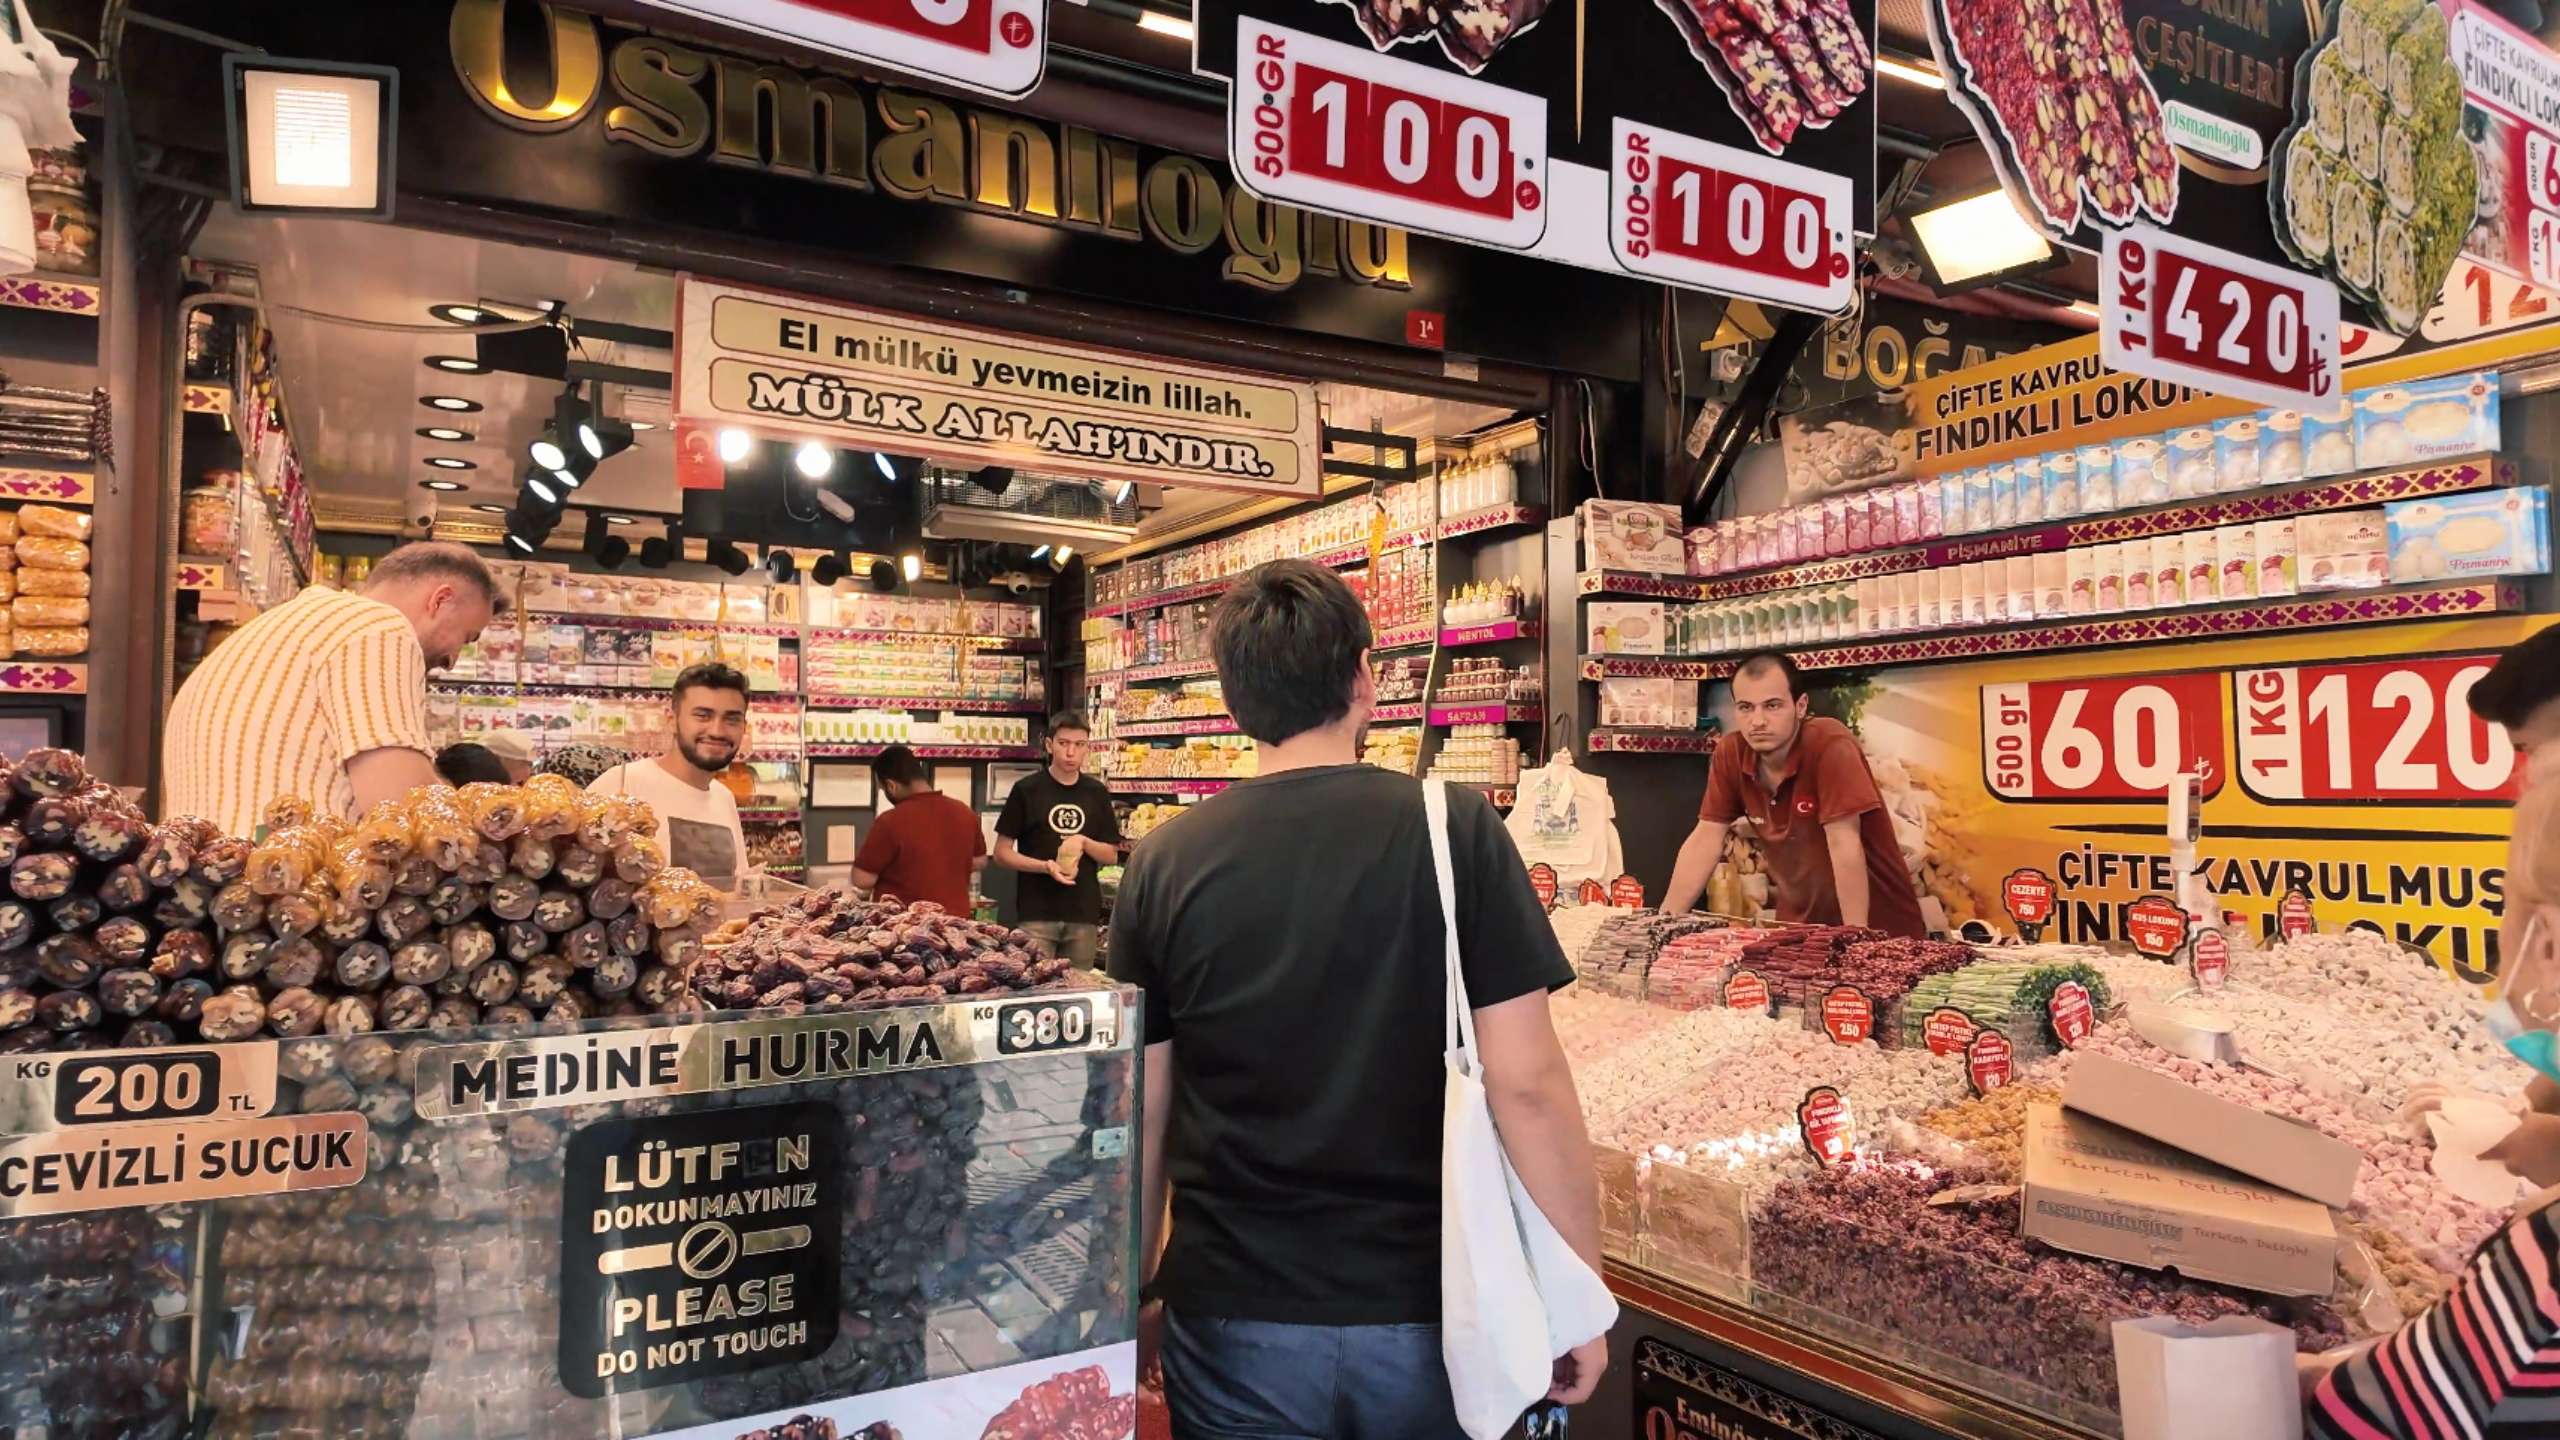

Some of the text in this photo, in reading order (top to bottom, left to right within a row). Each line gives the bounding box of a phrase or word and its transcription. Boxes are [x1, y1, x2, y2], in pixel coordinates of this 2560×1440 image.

[2136, 15, 2284, 109] ÇEŞİTLERİ
[1254, 33, 1286, 179] 500 GR
[1312, 81, 1500, 199] 100
[1626, 132, 1650, 259] 500 GR
[1672, 170, 1820, 270] 100
[2118, 239, 2146, 312] KG
[747, 371, 927, 434] MÜLK
[779, 317, 1253, 420] El mülkü yevmeizin lillah.
[1935, 378, 2004, 419] ÇİFTE
[1915, 378, 2213, 462] FINDIKLI LOKU
[1947, 534, 2043, 560] PİŞMANİYE
[1457, 628, 1496, 642] MENTOL
[1447, 710, 1486, 722] SAFRAN
[1996, 694, 2029, 790] 500 gr
[2247, 669, 2288, 778] 1 KG
[2308, 666, 2517, 792] 120
[2057, 842, 2172, 892] ÇİFTE
[973, 1005, 1117, 1048] KG 380 TL
[1839, 1022, 1860, 1037] 250
[16, 1061, 256, 1116] KG 200 TL
[451, 1021, 945, 1106] MEDİNE HURMA
[0, 1130, 353, 1198] CEVİZLİ SUCUK
[592, 1182, 818, 1234] DOKUNMAYINIZ
[613, 1273, 795, 1338] PLEASE
[597, 1320, 807, 1378] DO NOT TOUCH
